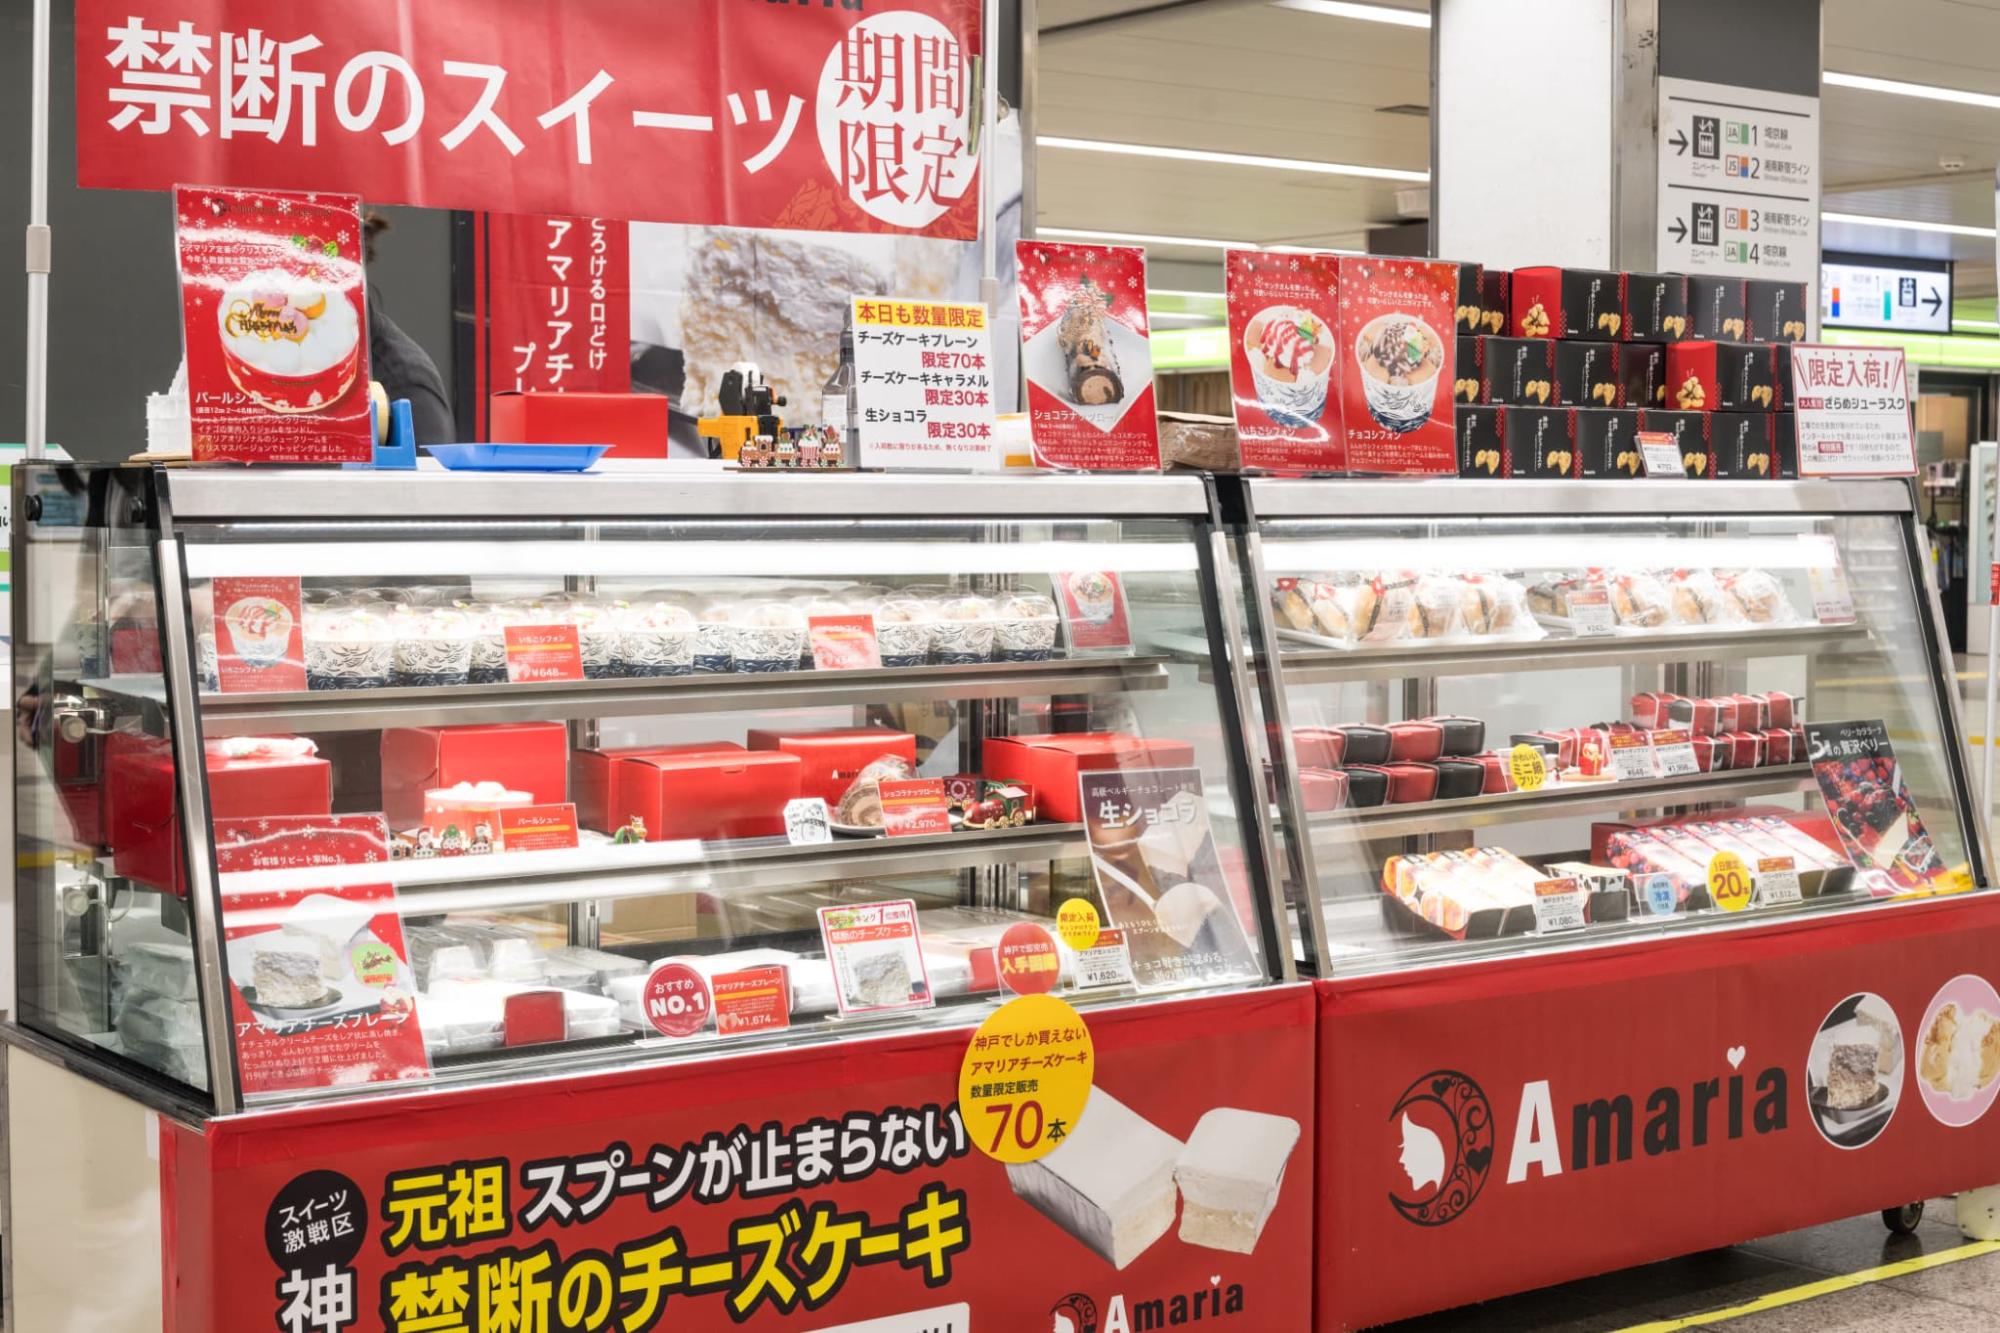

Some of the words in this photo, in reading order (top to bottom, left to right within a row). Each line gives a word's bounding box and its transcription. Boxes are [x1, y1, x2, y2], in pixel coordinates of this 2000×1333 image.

[834, 27, 966, 119] 期間
[105, 16, 806, 175] 禁断のスイーツ
[1727, 126, 1738, 138] JA
[1751, 125, 1758, 146] 1
[838, 120, 967, 206] 限定
[1728, 160, 1737, 171] JS
[1750, 157, 1760, 179] 2
[1728, 213, 1736, 224] JS
[1750, 209, 1760, 232] 3
[1749, 243, 1760, 265] 4
[858, 302, 984, 328] 本日も数量限定
[858, 330, 978, 348] チーズケーキプレーン
[921, 351, 986, 370] 限定70本
[860, 370, 989, 388] チーズケーキキャラメル
[1808, 358, 1889, 389] 限定入荷!
[925, 389, 989, 407] 限定30本
[1824, 396, 1906, 410] ざらめシューラスク
[865, 407, 928, 423] 生ショコラ
[927, 421, 992, 440] 限定30本
[1348, 429, 1402, 441] チョコシフォン
[531, 667, 560, 678] ¥648
[1519, 776, 1542, 786] プリン
[1099, 799, 1198, 829] 生ショコラ
[654, 978, 694, 994] おすすめ
[714, 977, 782, 992] アマリアチーズプレーン
[1087, 970, 1117, 981] ¥1,620
[649, 991, 706, 1018] NO.1
[737, 1014, 772, 1027] ¥1,674
[974, 1027, 1087, 1052] 神戸でしか買えない
[971, 1050, 1088, 1076] アマリアチーズケーキ
[970, 1079, 1039, 1099] 数量限定販売
[985, 1099, 1067, 1153] 70本
[1506, 1046, 1789, 1184] Amaria
[388, 1164, 505, 1248] 元祖
[525, 1107, 966, 1224] スプーンが止まらない
[279, 1189, 348, 1229] スイーツ
[282, 1211, 355, 1254] 激戦区
[388, 1190, 964, 1333] 禁断のチーズケーキ
[281, 1263, 352, 1333] 神
[1102, 1275, 1244, 1333] Amaria
